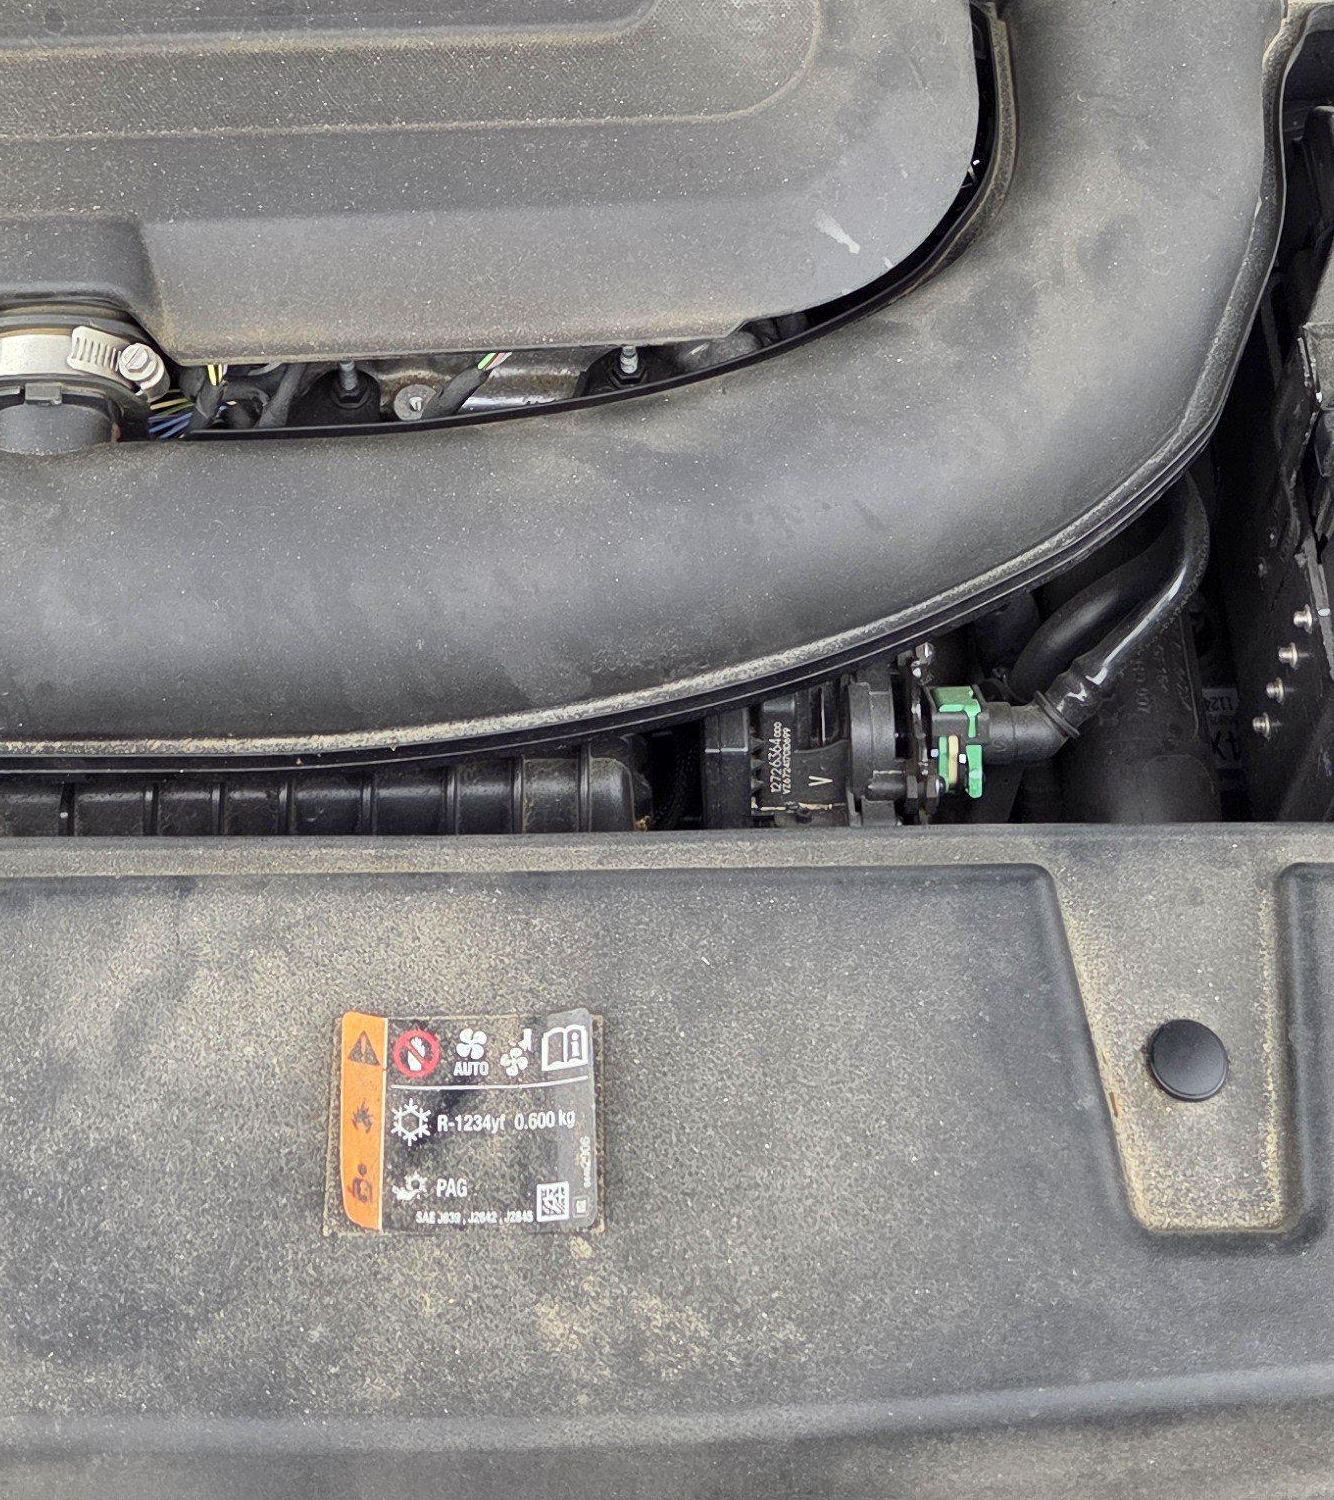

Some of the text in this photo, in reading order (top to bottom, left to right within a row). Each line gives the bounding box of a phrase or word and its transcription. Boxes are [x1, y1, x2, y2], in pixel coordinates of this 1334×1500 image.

[453, 1061, 489, 1077] AUTO
[437, 1109, 575, 1134] R-1234yf 0.600 kg
[436, 1178, 468, 1198] PAG
